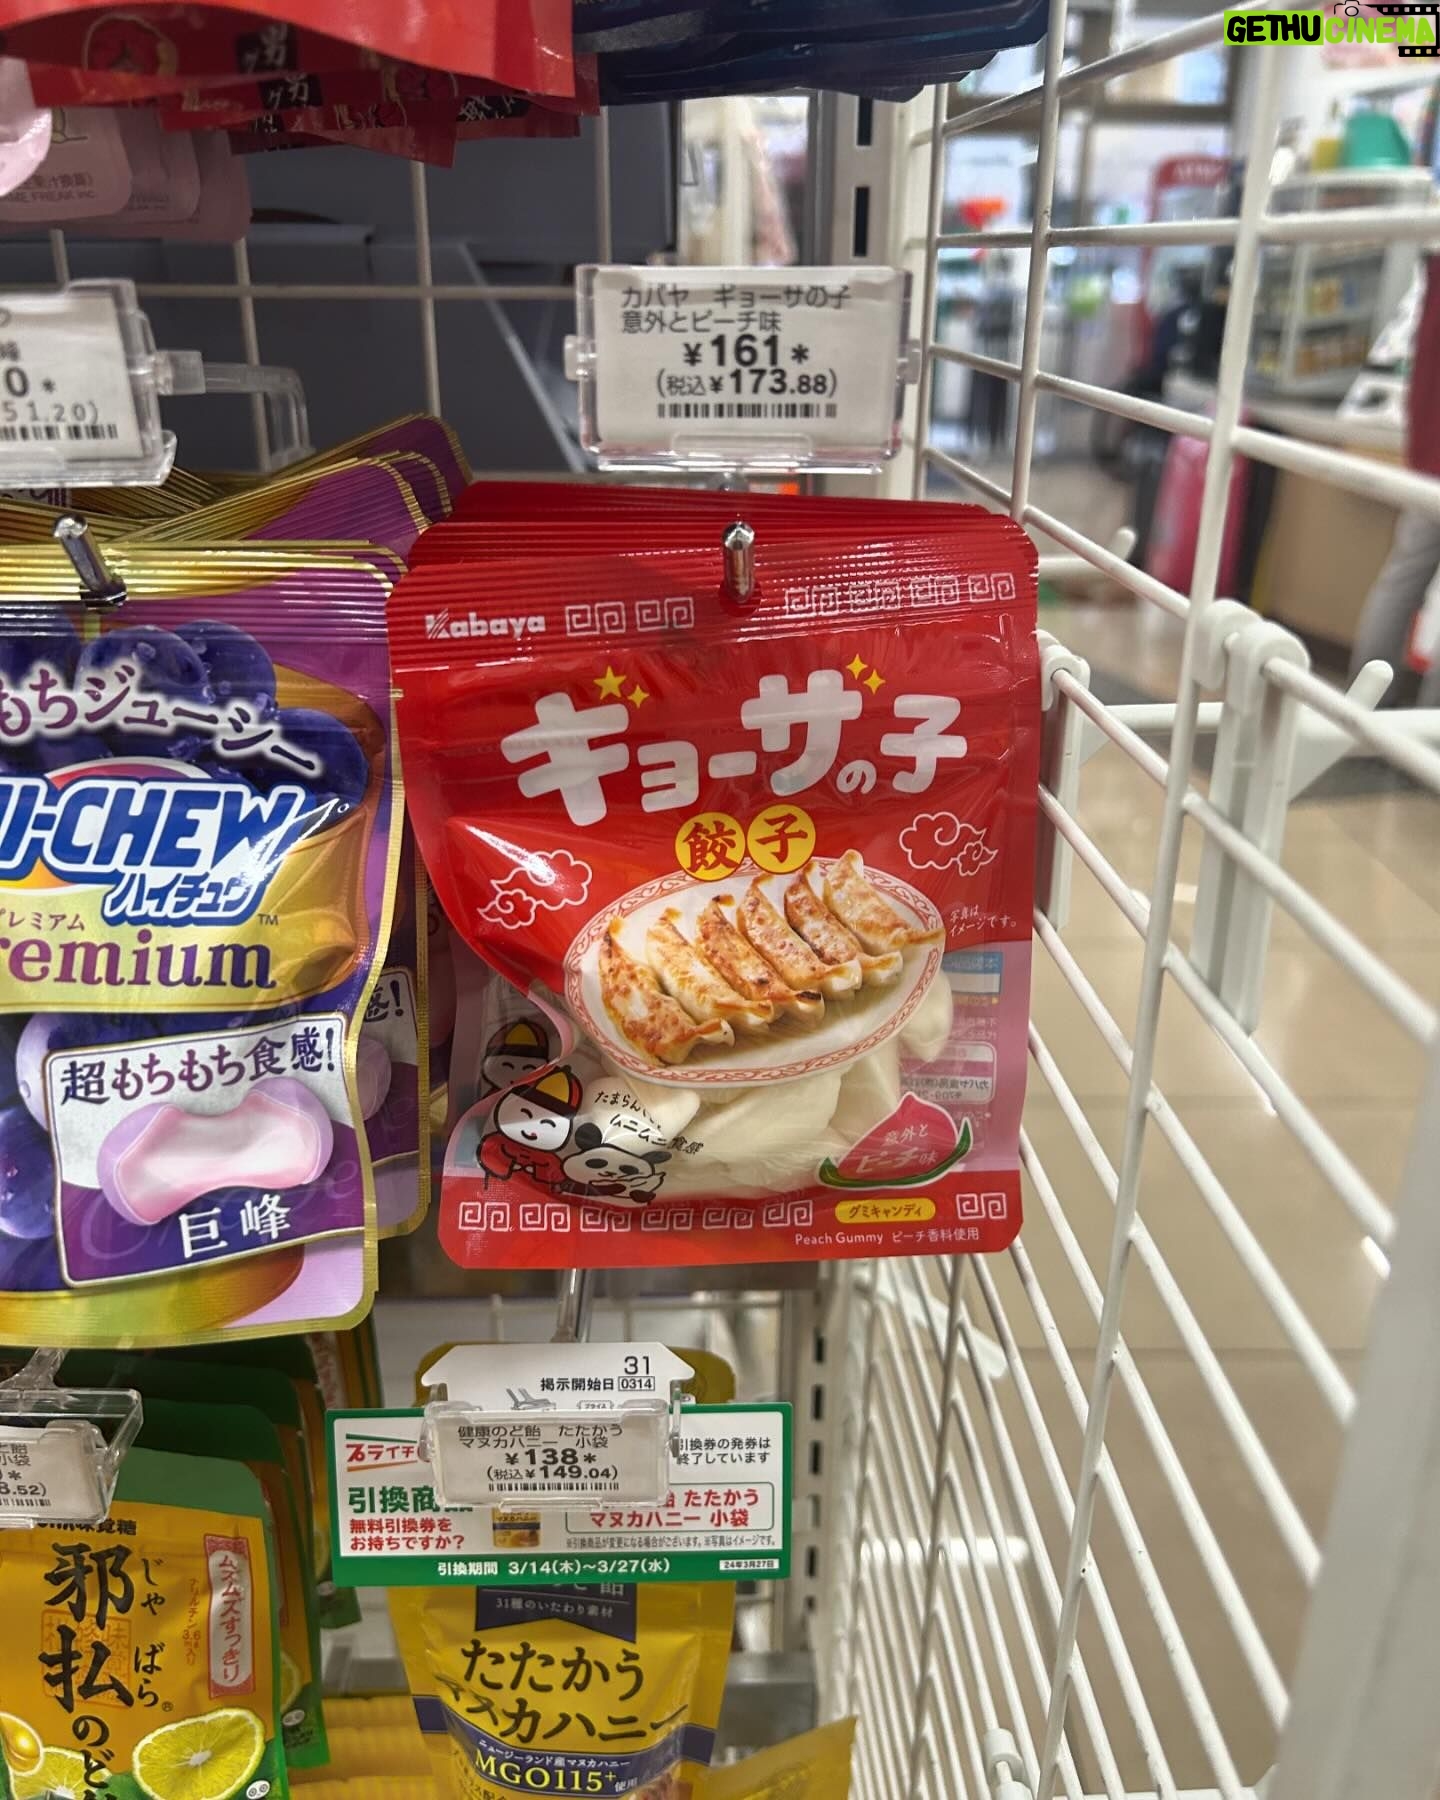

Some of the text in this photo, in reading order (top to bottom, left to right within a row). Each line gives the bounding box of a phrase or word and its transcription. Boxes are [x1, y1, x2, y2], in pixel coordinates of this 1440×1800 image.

[621, 286, 851, 308] カバヤ ギョーサの子
[621, 311, 782, 333] 意外とピーチ味
[657, 368, 838, 398] (税込¥173.88)
[425, 608, 546, 640] Kabaya
[500, 669, 969, 827] ギョーサの子
[681, 812, 810, 874] 餃子
[60, 1026, 335, 1106] 超もちもち食感!
[848, 1202, 922, 1220] グミキャンディ
[180, 1194, 291, 1259] 巨峰
[795, 1226, 979, 1246] Peach Gummy ピーチ香料使用
[624, 1355, 650, 1375] 31
[540, 1377, 652, 1392] 掲示開始日 0314
[458, 1424, 624, 1438] 健康のど飴 たたかう
[460, 1437, 609, 1449] マヌカハニー 小袋
[676, 1451, 770, 1466] 終了しています
[487, 1465, 618, 1481] (税込¥149.04)
[348, 1486, 474, 1514] 引換商
[684, 1489, 759, 1508] たたかう
[350, 1517, 453, 1534] 無料引換券を
[590, 1508, 749, 1528] マヌカハニー 小袋
[350, 1534, 466, 1551] お持ちですか?
[437, 1561, 499, 1576] 引換期間
[495, 1597, 613, 1618] 31種のいたわり素材
[460, 1638, 645, 1703] たたかう
